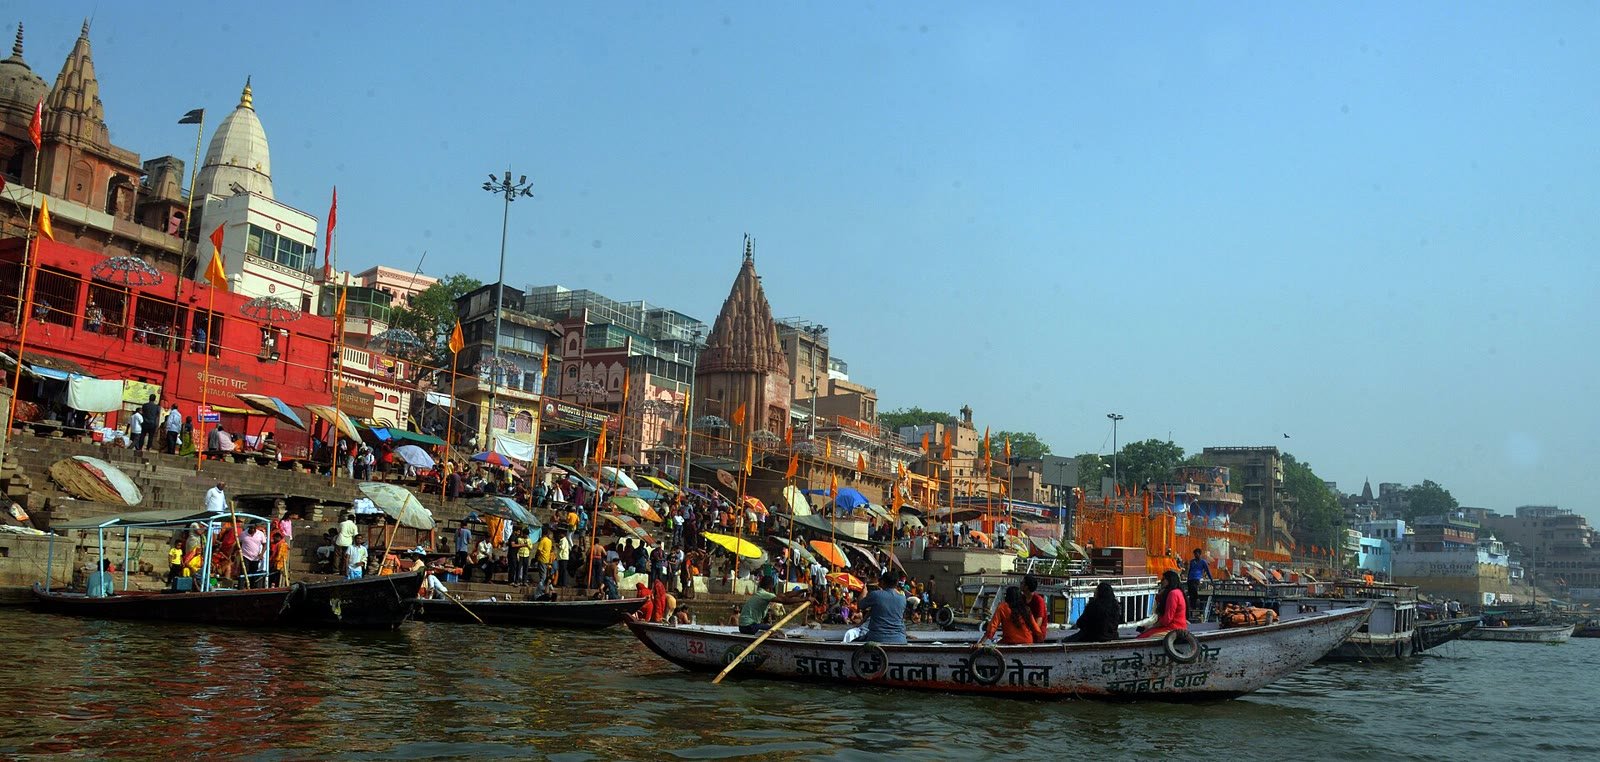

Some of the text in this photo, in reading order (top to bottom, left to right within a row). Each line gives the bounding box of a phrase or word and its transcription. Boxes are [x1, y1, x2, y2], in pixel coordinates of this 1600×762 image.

[231, 378, 248, 391] घाट
[688, 640, 705, 655] 32
[1007, 658, 1053, 687] तेल
